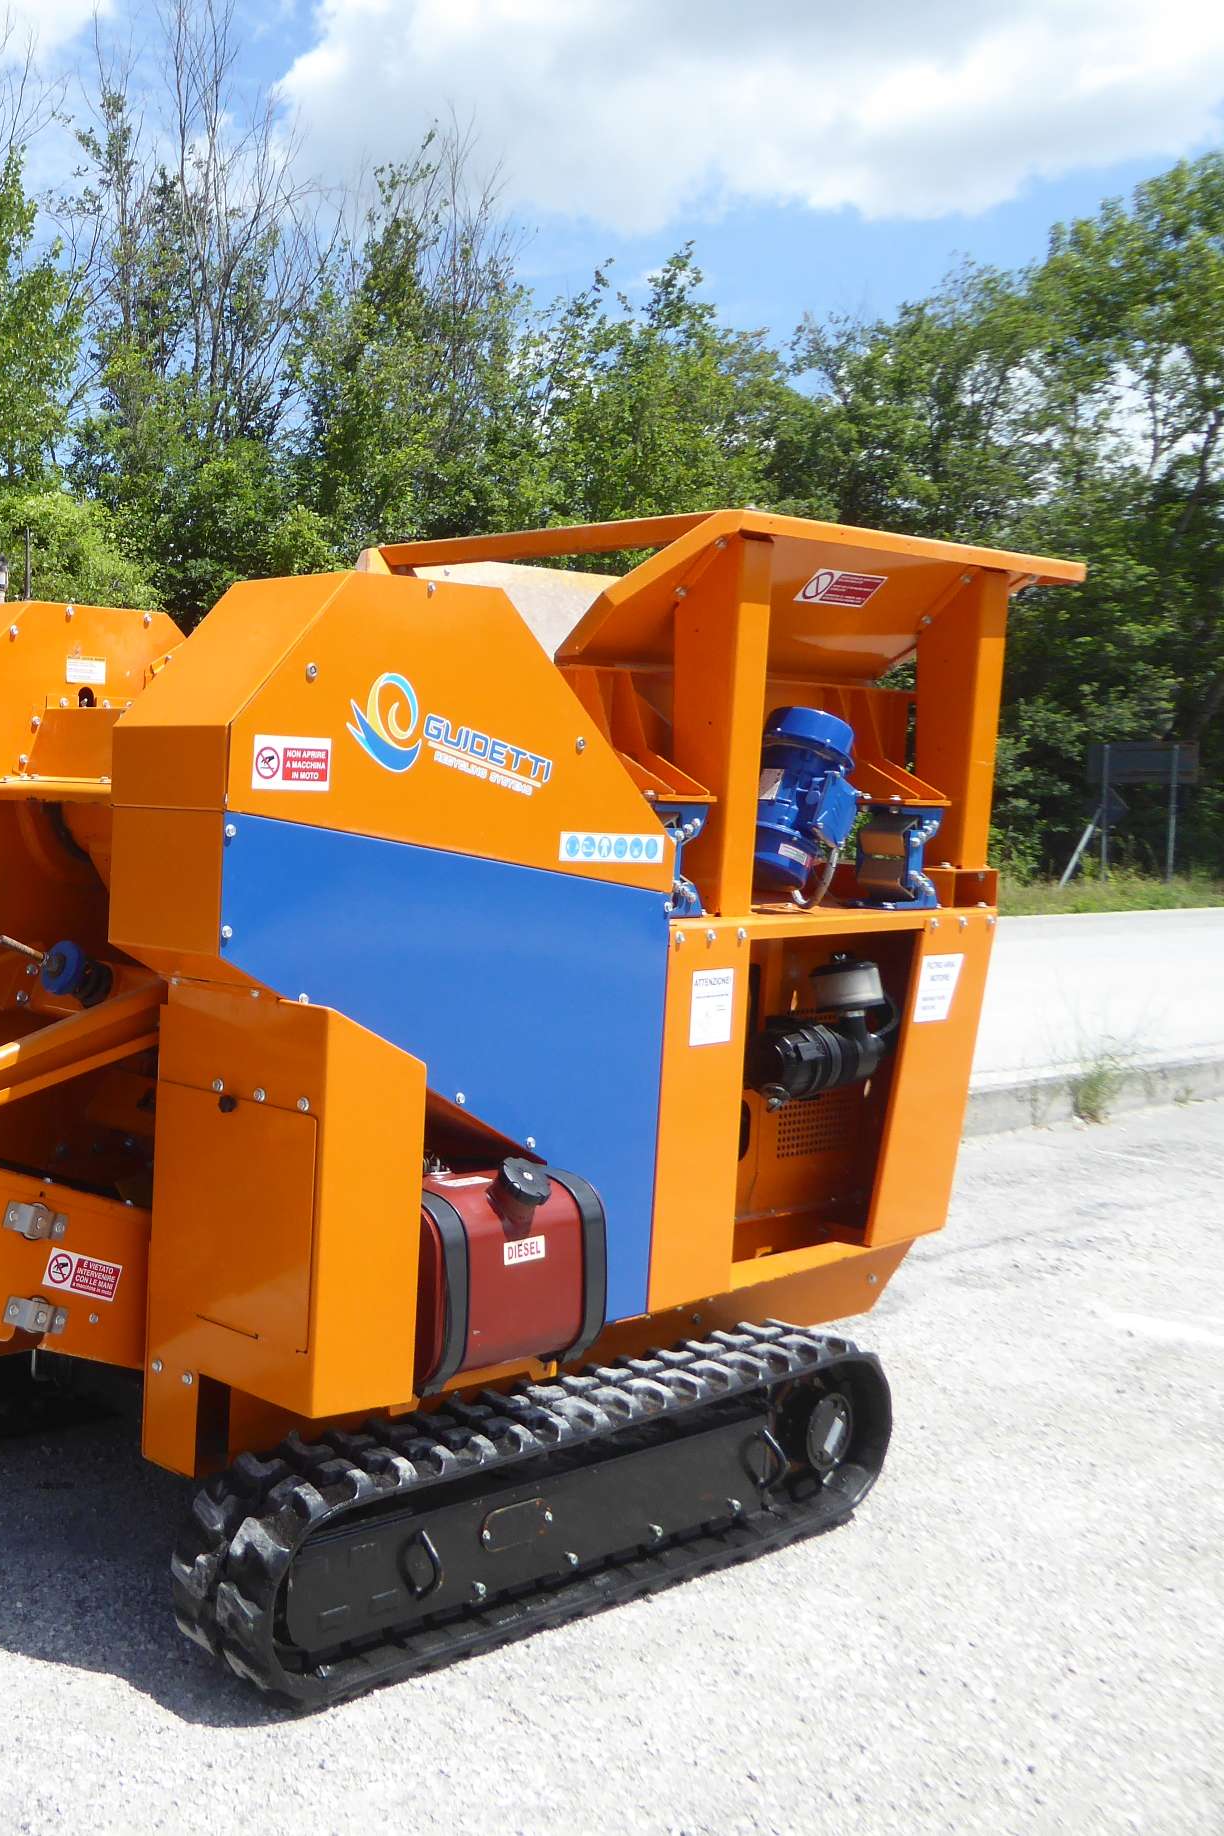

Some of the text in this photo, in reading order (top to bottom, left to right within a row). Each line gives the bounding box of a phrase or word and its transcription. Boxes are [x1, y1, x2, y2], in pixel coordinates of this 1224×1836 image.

[287, 750, 301, 758] NON
[424, 714, 552, 782] GUIDETTI
[286, 760, 326, 769] A MACCHINA
[291, 771, 319, 779] IN MOTO
[507, 1241, 541, 1260] DIESEL
[89, 1261, 113, 1274] VIETATO
[75, 1274, 114, 1290] CON LE MANI
[77, 1267, 116, 1283] INTERVENIRE
